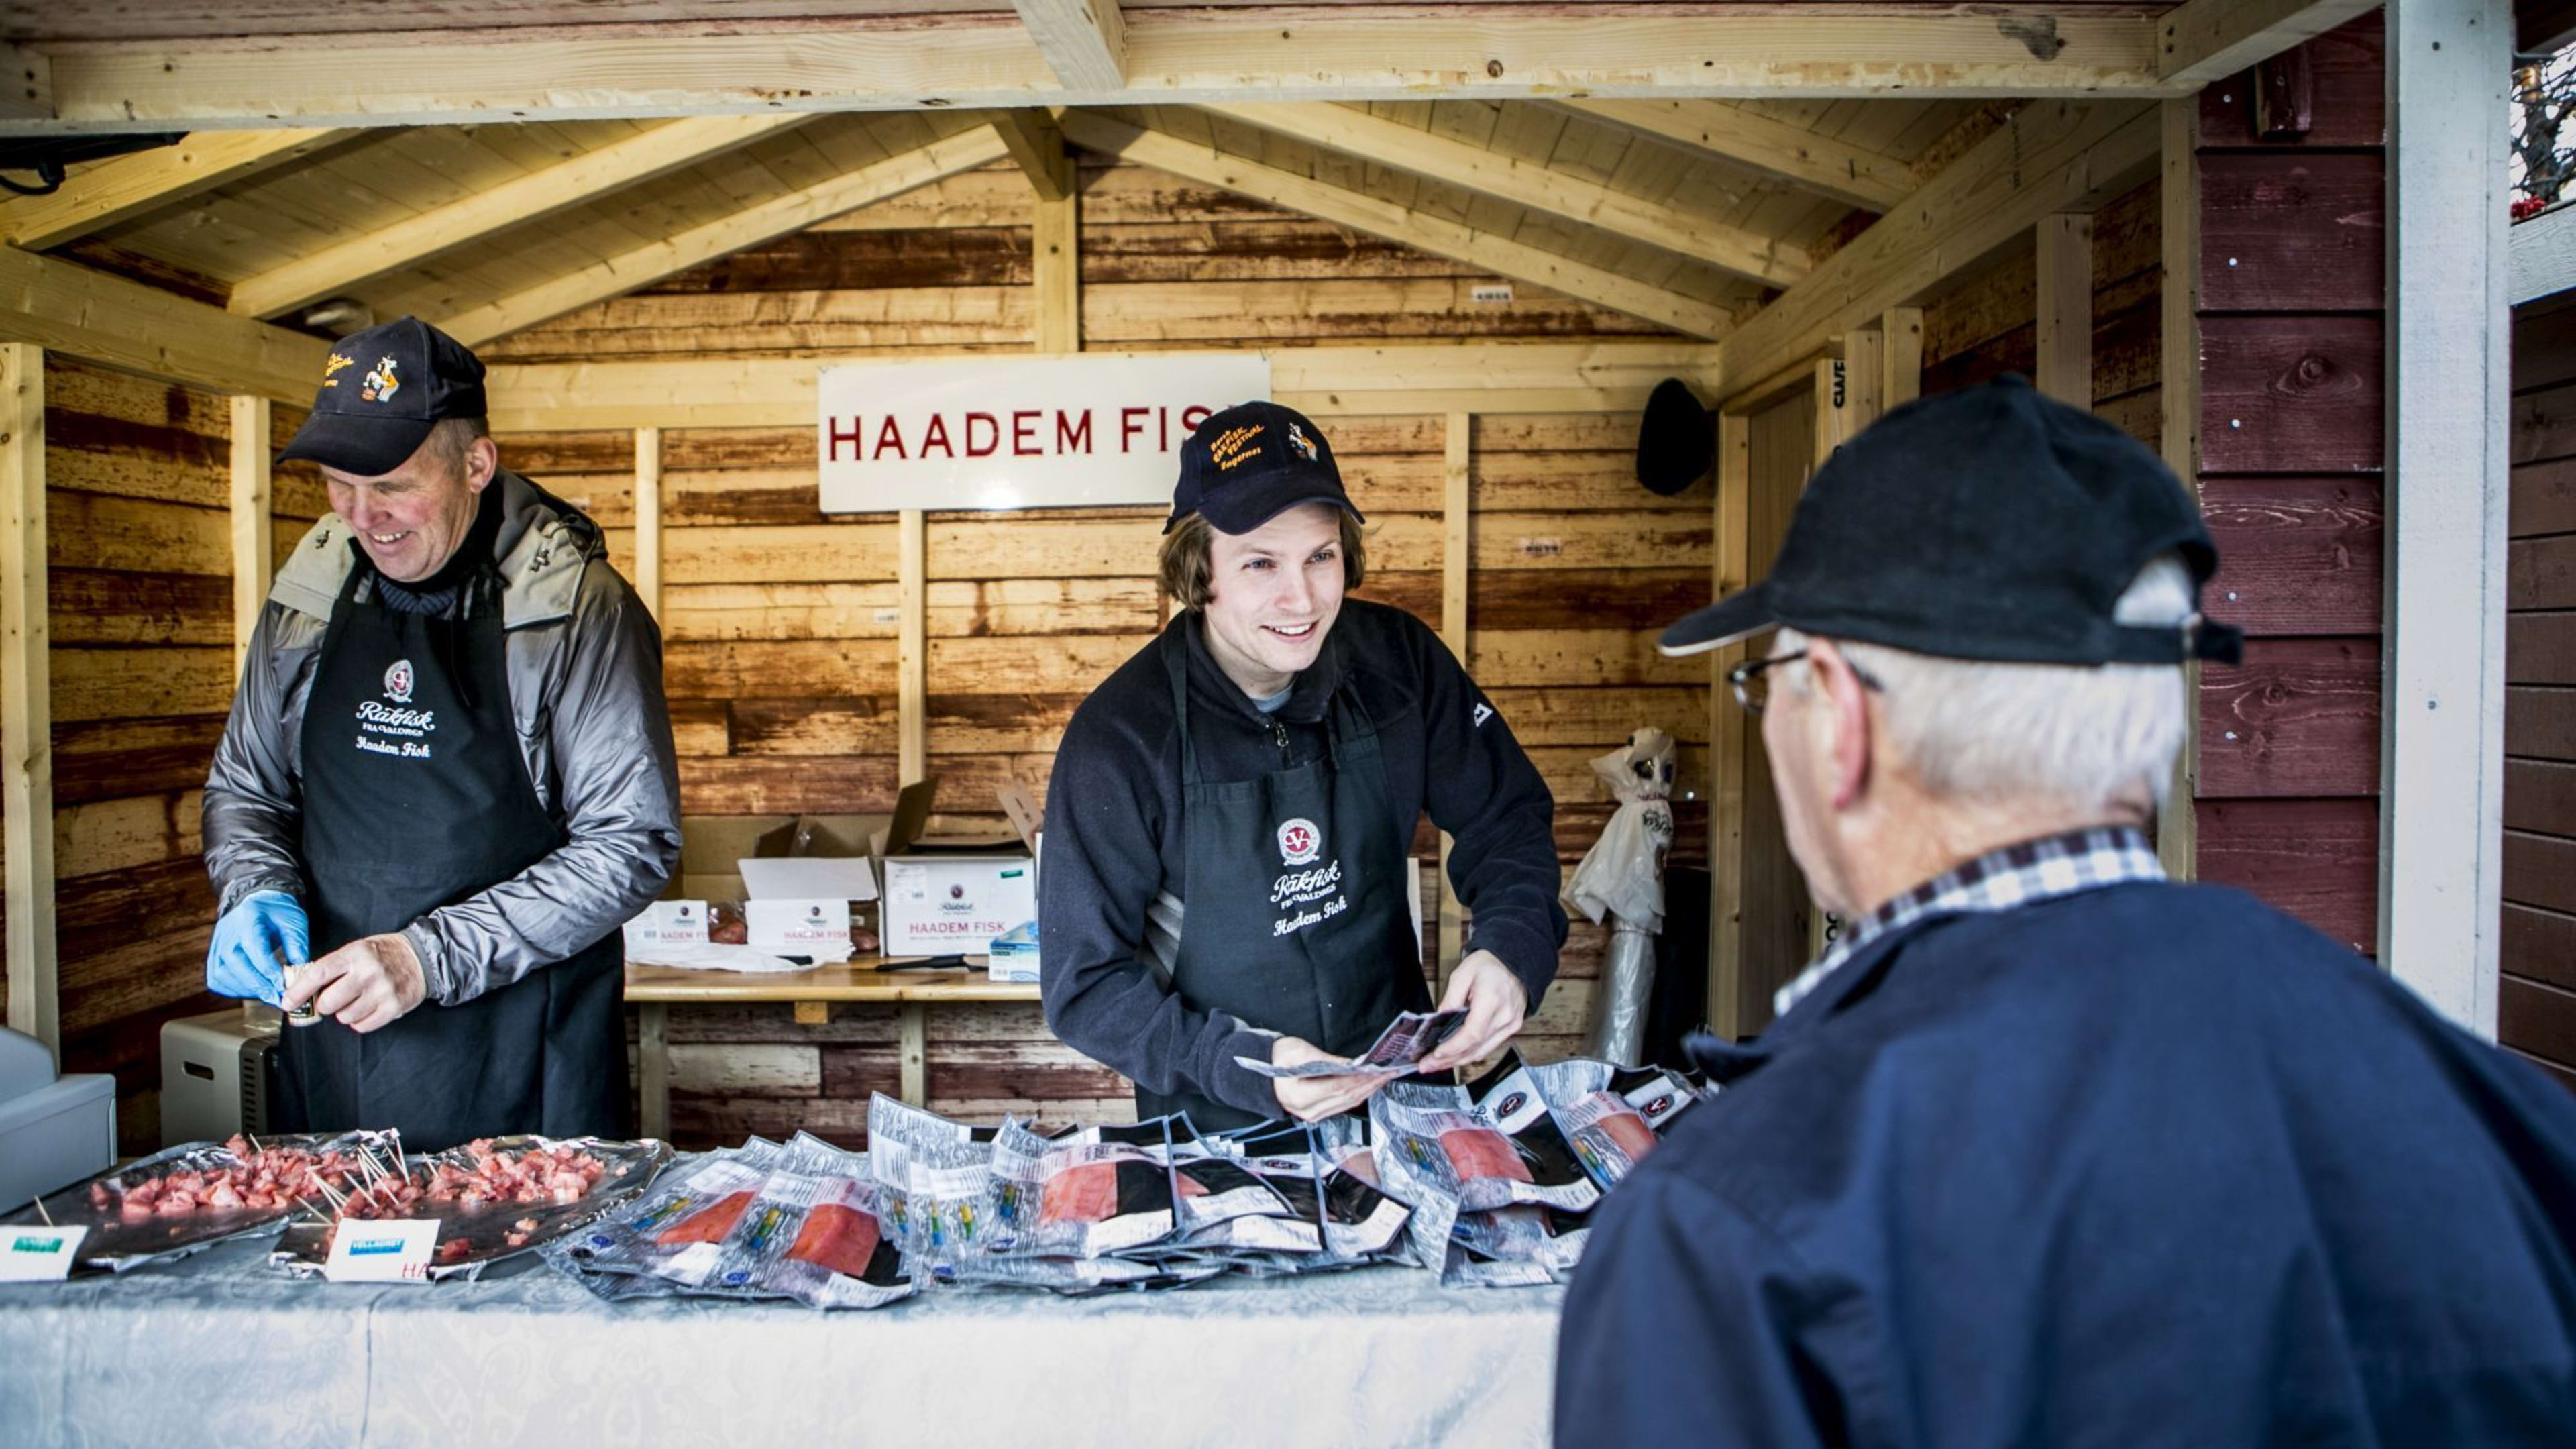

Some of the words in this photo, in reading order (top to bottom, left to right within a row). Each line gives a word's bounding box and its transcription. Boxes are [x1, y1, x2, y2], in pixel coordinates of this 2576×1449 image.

[828, 408, 1093, 462] HAADEM
[1121, 404, 1216, 454] FIS
[1227, 424, 1265, 455] FESTIVAL
[356, 735, 400, 755] Haadem
[401, 741, 431, 758] Fisk
[909, 922, 969, 934] HAADEM
[974, 921, 1006, 932] FISK
[1273, 910, 1322, 936] Haadem
[1323, 894, 1348, 920] Fisk
